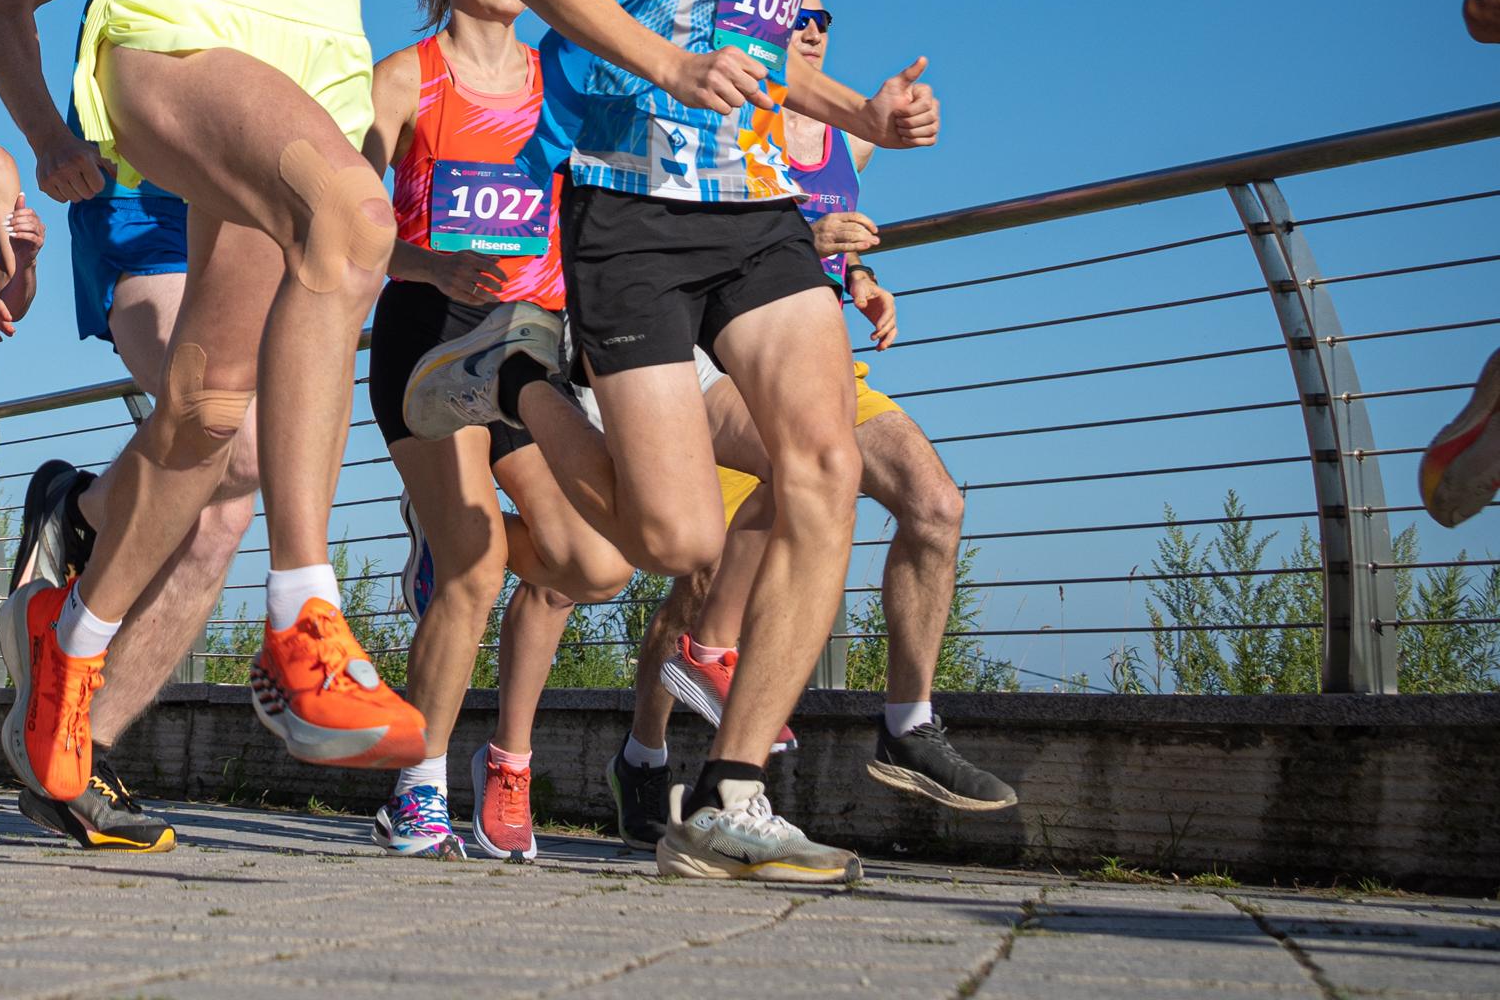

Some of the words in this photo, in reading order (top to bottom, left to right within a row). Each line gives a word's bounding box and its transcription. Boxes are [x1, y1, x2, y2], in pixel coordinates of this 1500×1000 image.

[448, 186, 544, 221] 1027
[811, 193, 841, 205] PFEST
[471, 239, 521, 251] Hisense
